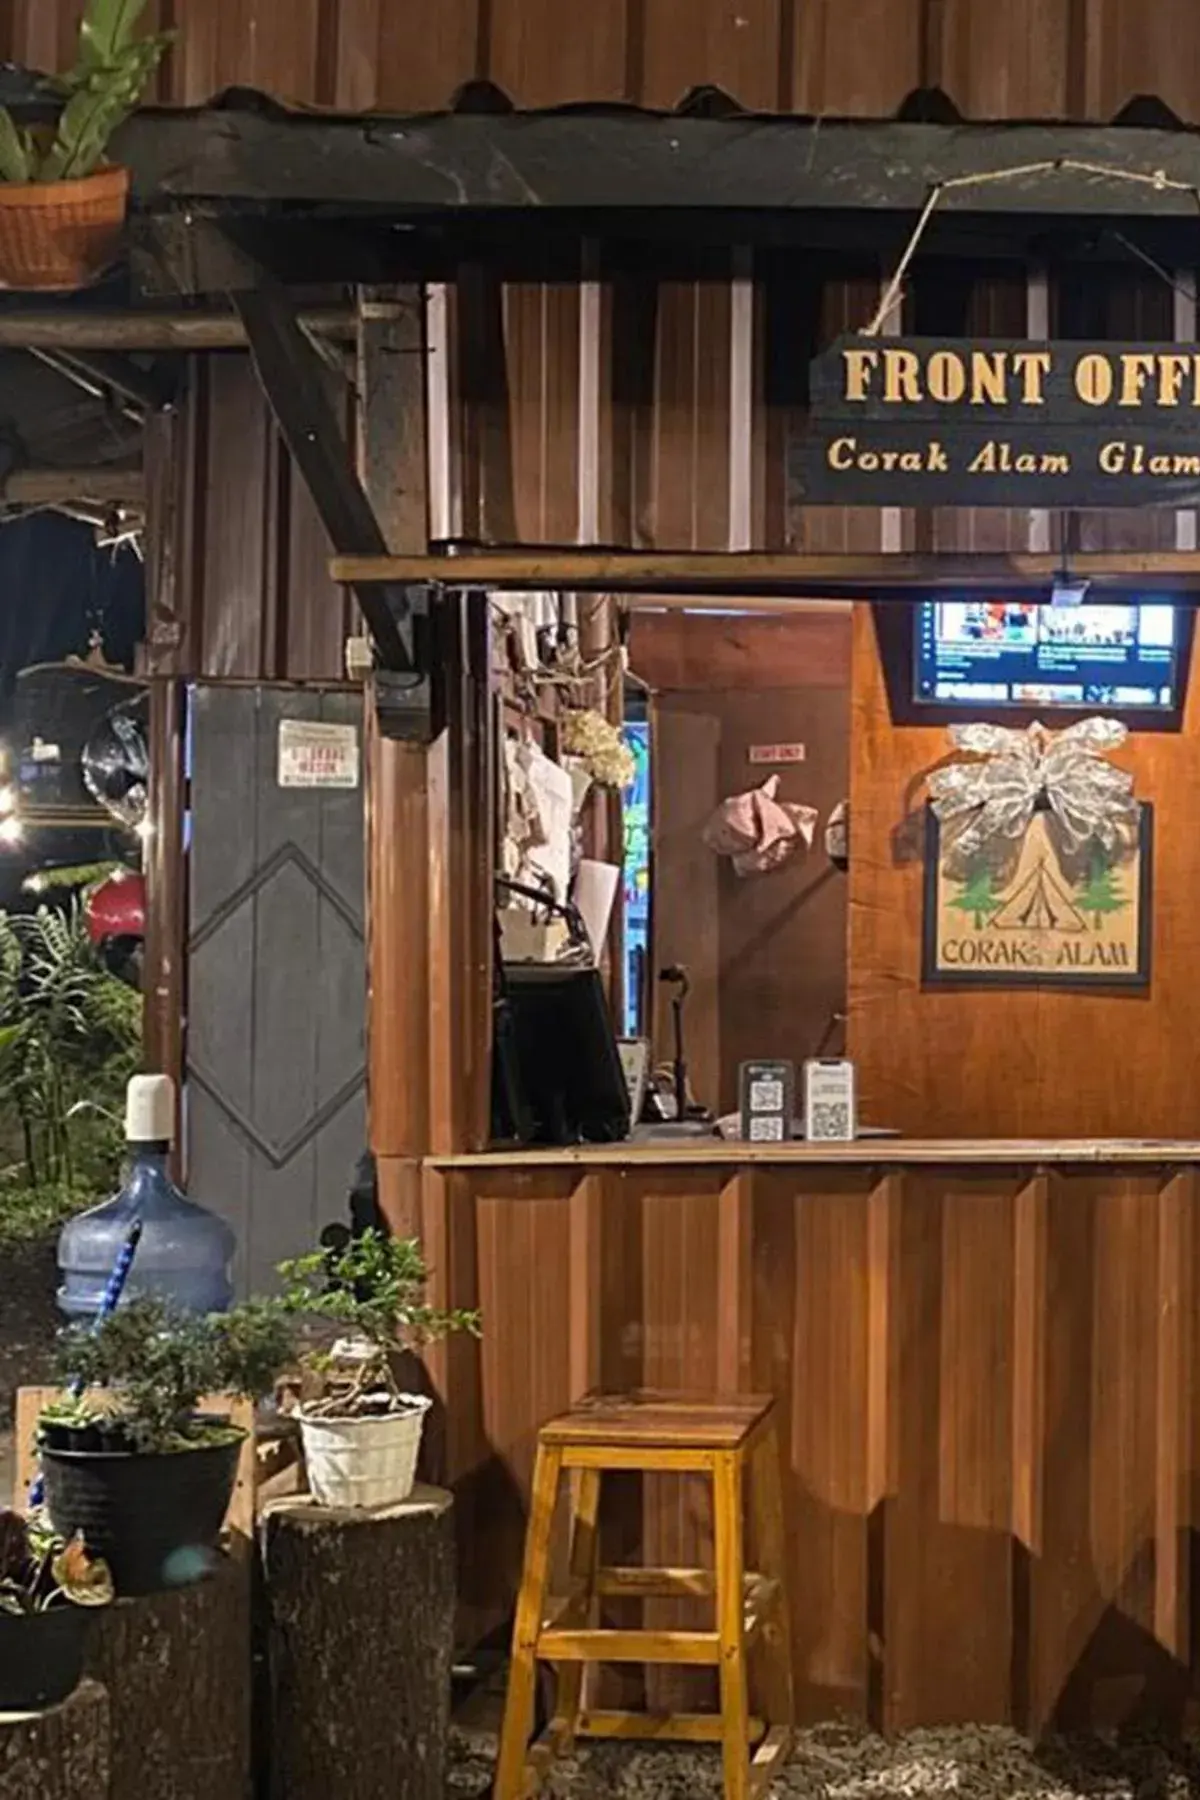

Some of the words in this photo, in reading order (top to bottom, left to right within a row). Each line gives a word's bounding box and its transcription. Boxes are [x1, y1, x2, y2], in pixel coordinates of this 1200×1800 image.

[843, 350, 1051, 404] FRONT
[828, 438, 949, 472] Corak
[968, 441, 1070, 474] Alam
[941, 939, 1029, 965] CORAK
[1056, 941, 1130, 967] ALAM
